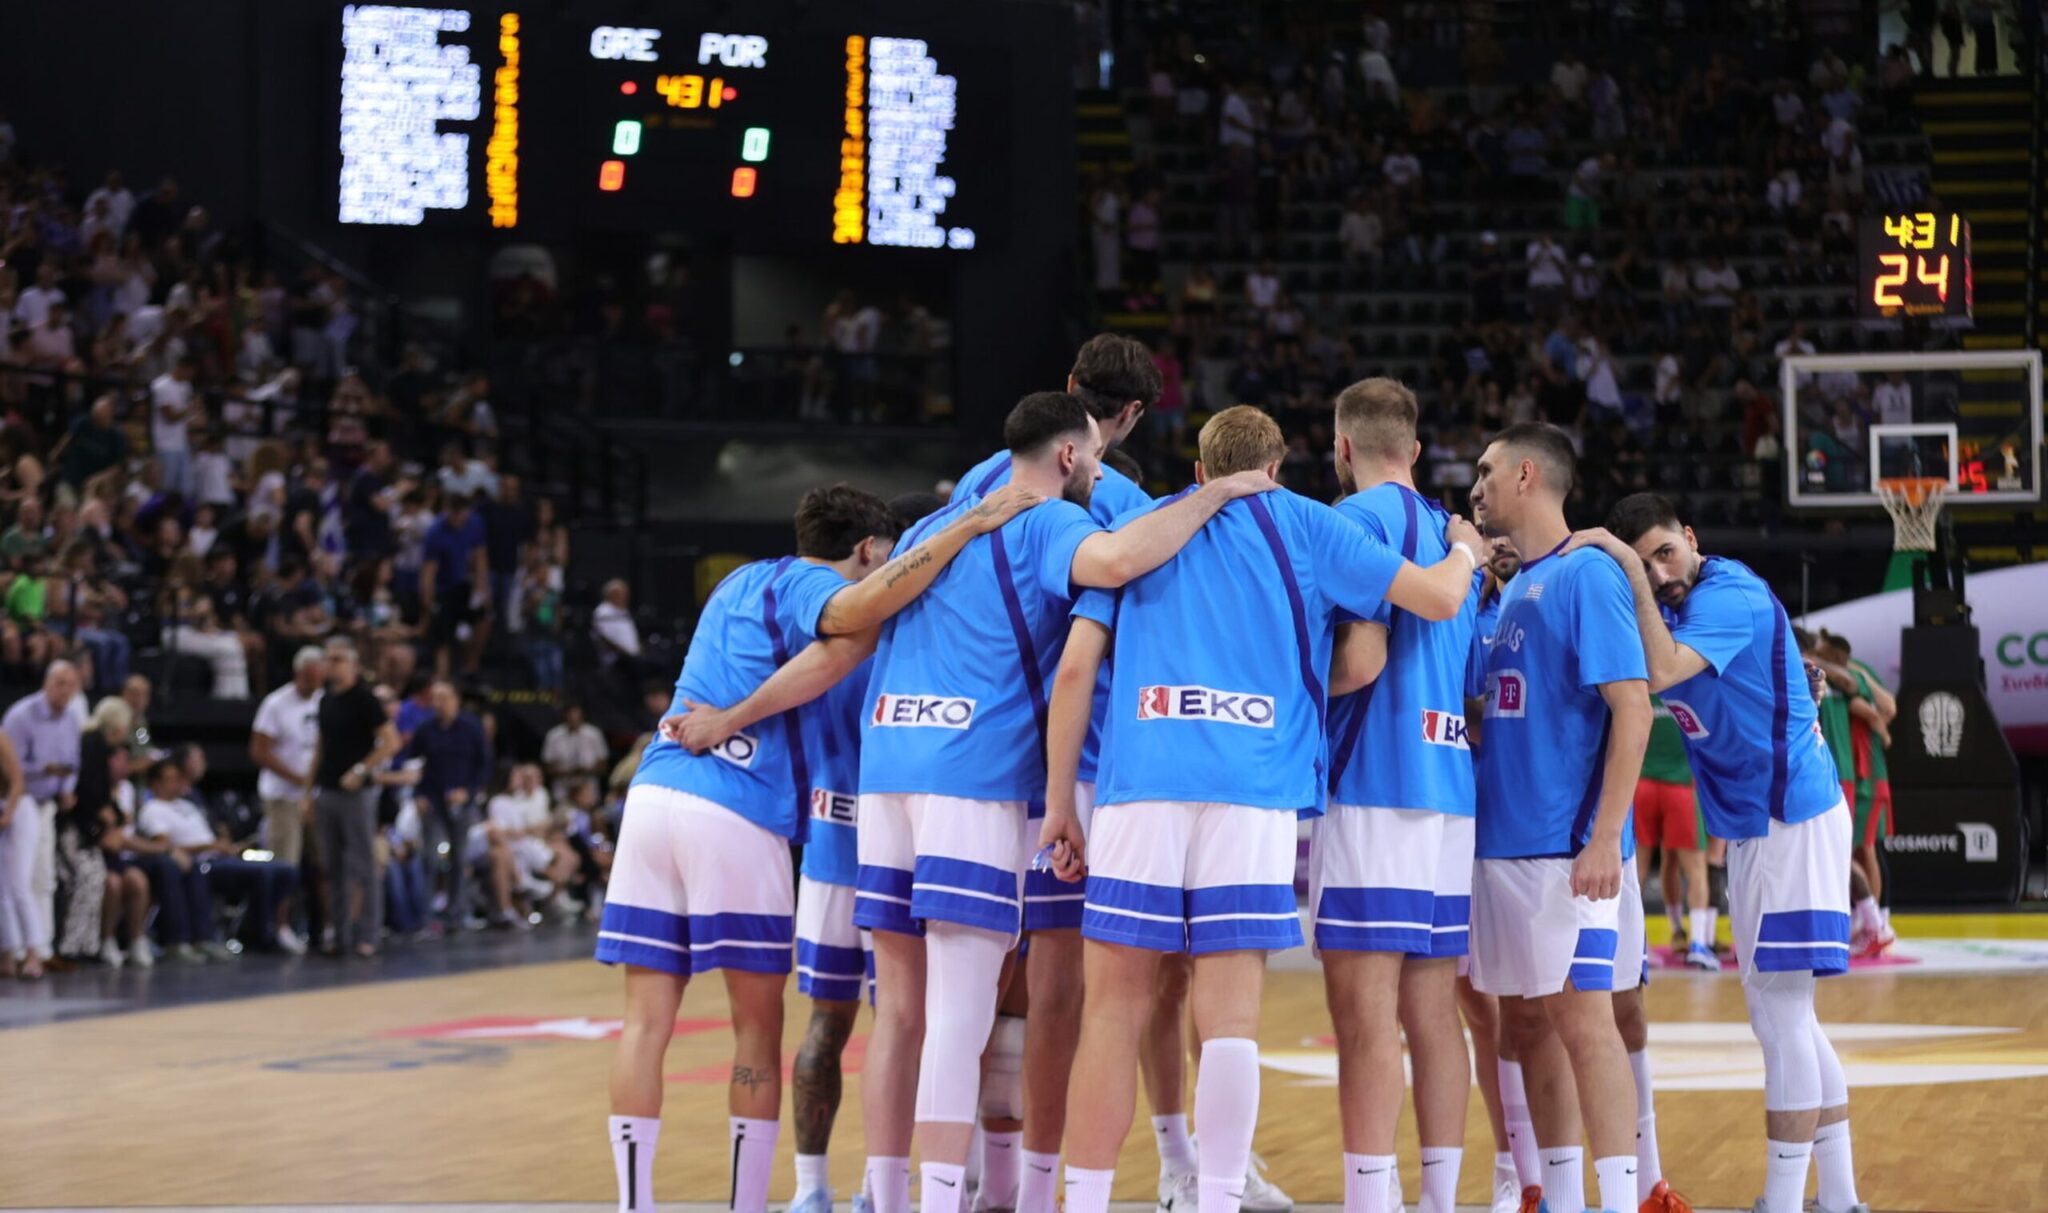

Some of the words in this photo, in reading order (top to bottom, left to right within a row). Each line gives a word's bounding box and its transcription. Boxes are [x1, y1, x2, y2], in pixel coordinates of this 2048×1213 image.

[590, 26, 661, 61] GRE
[698, 33, 768, 68] POR
[613, 120, 641, 155] 0
[742, 127, 770, 161] 0
[1875, 253, 1949, 306] 24
[892, 698, 972, 726] EKO
[1179, 689, 1273, 724] EKO
